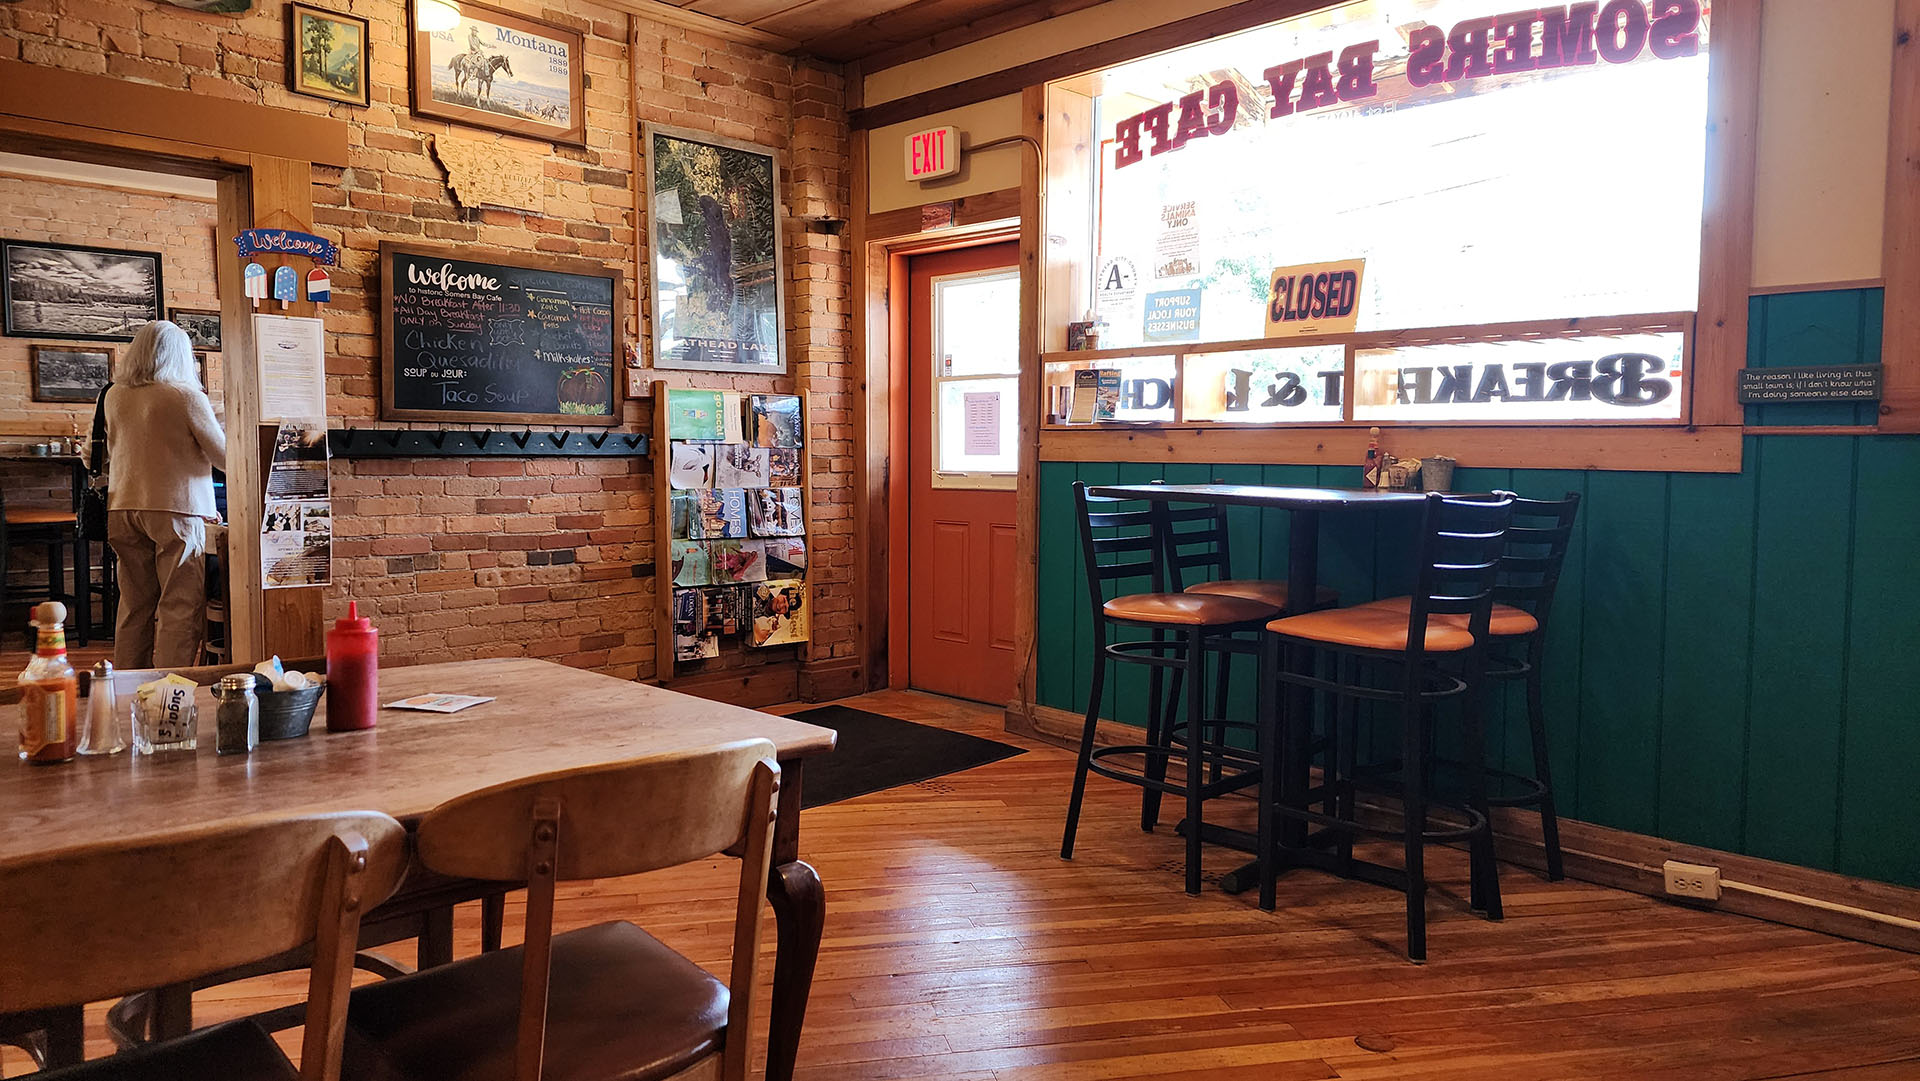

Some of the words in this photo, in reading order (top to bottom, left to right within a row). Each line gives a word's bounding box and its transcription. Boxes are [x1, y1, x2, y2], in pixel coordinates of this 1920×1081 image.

[495, 26, 568, 58] Montana
[549, 56, 568, 67] 1889
[549, 65, 568, 76] 1989
[912, 129, 947, 176] EXIT
[248, 231, 324, 255] Welcome
[408, 263, 502, 291] Welcome
[408, 286, 417, 294] to
[444, 290, 471, 299] Somers
[472, 293, 485, 303] Bay
[421, 296, 469, 309] Breakfast
[472, 302, 495, 311] After
[536, 295, 570, 307] Cinnamon
[1270, 269, 1358, 323] CLOSED
[399, 306, 414, 315] All
[416, 307, 438, 321] Day
[440, 308, 486, 320] Breakfast
[537, 311, 571, 322] Caramel
[400, 316, 425, 326] ONLY
[447, 319, 483, 335] Sunday
[405, 329, 484, 352] Chicken
[403, 367, 428, 378] SOUP
[430, 371, 439, 379] DU
[441, 368, 468, 379] JOUR:
[1746, 373, 1761, 381] The
[1762, 373, 1792, 381] reason
[1798, 372, 1814, 380] like
[1816, 371, 1841, 381] living
[1843, 370, 1853, 378] in
[1855, 370, 1872, 378] this
[431, 380, 479, 405] Taco
[484, 382, 529, 404] Soup
[1743, 382, 1763, 390] small
[1765, 382, 1785, 390] town
[1796, 381, 1802, 390] if
[1808, 380, 1828, 389] don't
[1830, 380, 1852, 388] know
[1854, 379, 1876, 387] what
[713, 393, 722, 408] go
[1748, 391, 1761, 399] I'm
[1762, 391, 1788, 400] doing
[1789, 390, 1828, 398] someone
[1851, 389, 1873, 397] does
[715, 409, 724, 437] local
[728, 490, 742, 535] HOMES
[687, 595, 695, 617] LOGAN
[167, 688, 186, 727] Sugar
